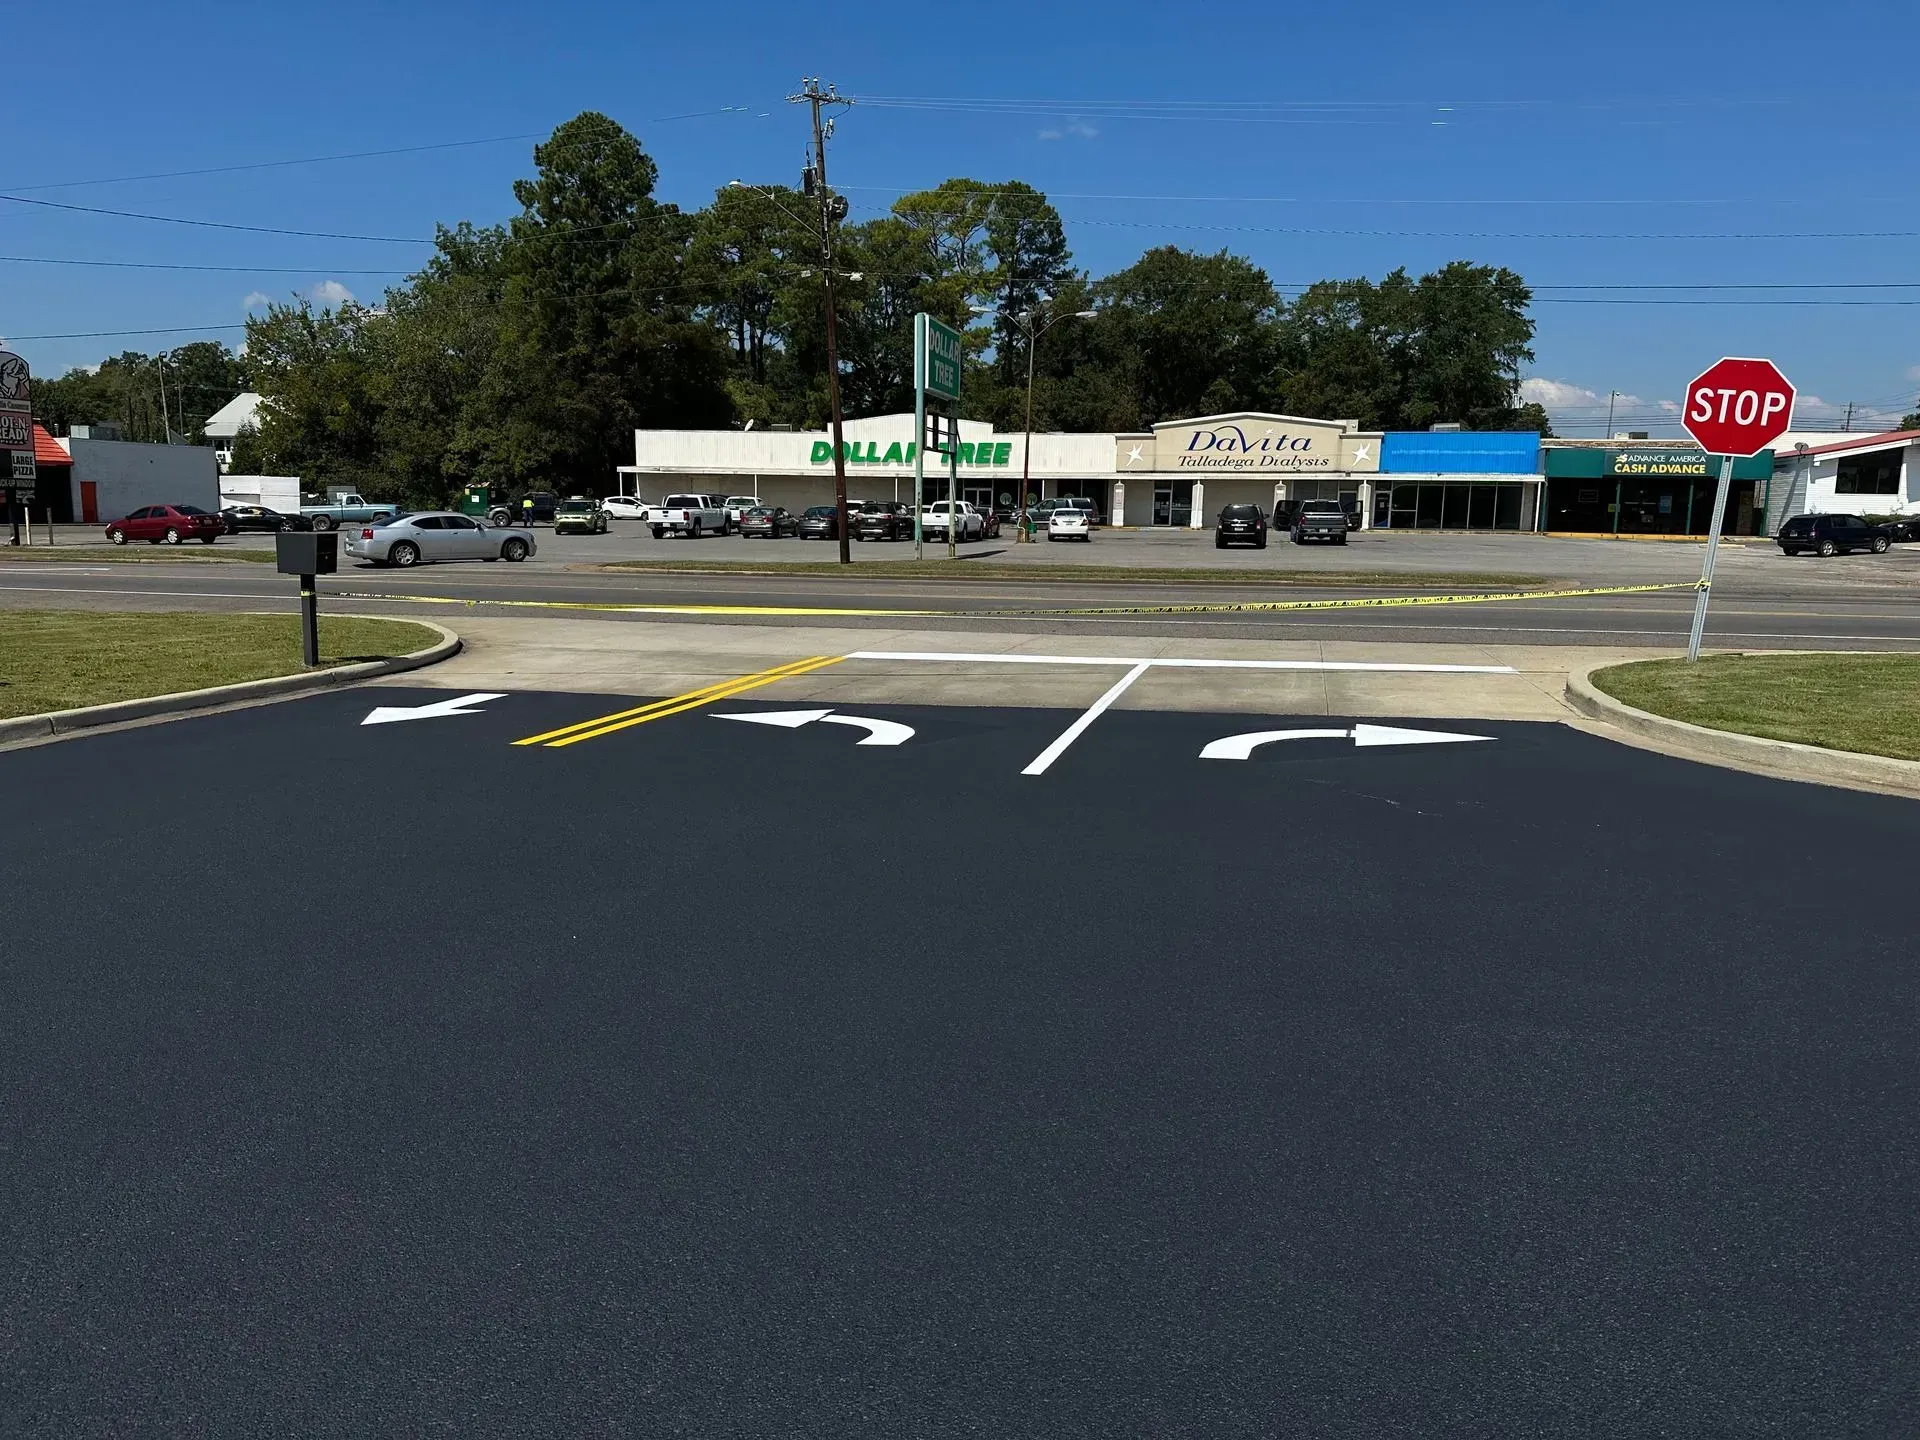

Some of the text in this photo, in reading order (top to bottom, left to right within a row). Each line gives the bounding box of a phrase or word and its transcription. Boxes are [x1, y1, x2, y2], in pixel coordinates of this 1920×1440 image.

[929, 328, 960, 364] DOLLAR
[934, 359, 953, 388] TREE
[1691, 387, 1786, 427] STOP
[0, 416, 30, 429] OT-N-
[1185, 425, 1312, 454] DaVita
[13, 456, 33, 465] LARGE
[938, 442, 1012, 464] TREE
[14, 466, 34, 475] PIZZA
[1178, 455, 1330, 470] Talladega Dialysis
[1614, 464, 1706, 474] CASH ADVANCE
